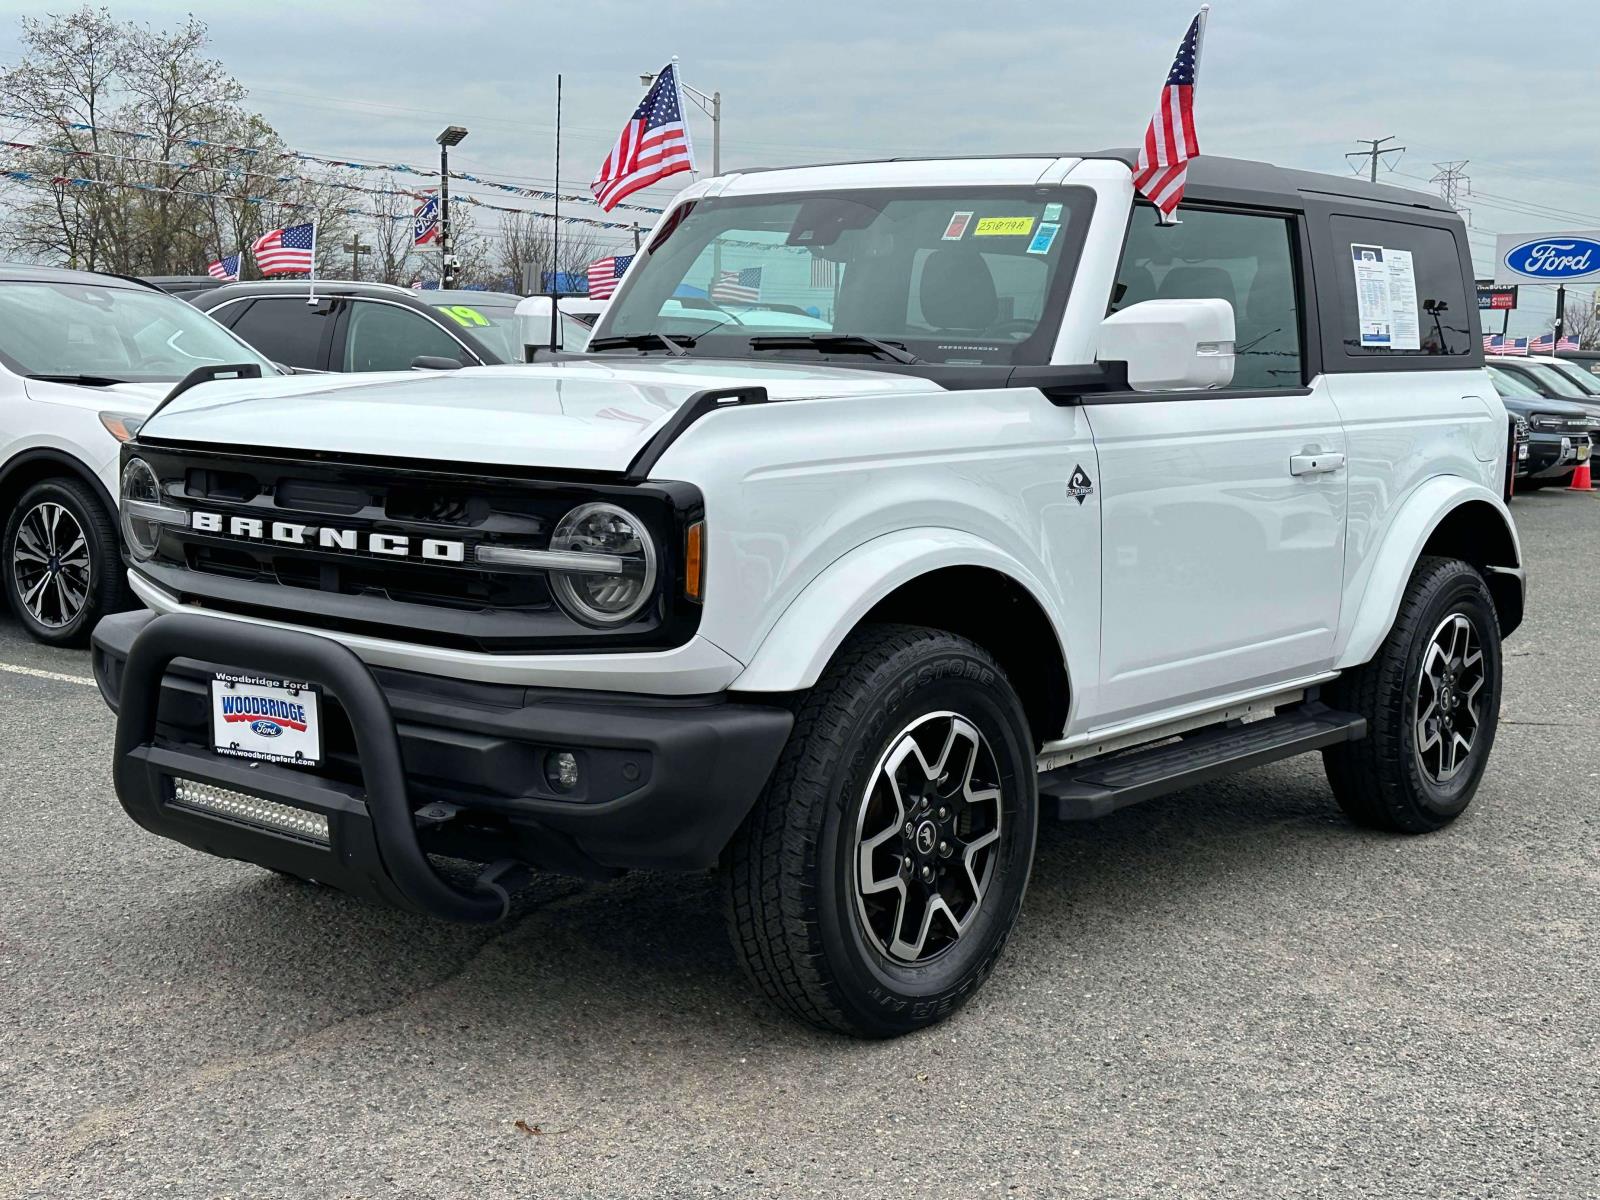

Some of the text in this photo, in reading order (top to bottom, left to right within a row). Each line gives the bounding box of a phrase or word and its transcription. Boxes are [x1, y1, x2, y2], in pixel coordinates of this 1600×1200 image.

[414, 201, 439, 234] Ford
[1524, 244, 1593, 272] Ford
[438, 305, 491, 327] 19
[192, 511, 465, 562] BRONCO
[215, 672, 309, 690] Woodbridge Ford
[222, 696, 306, 724] WOODBRIDGE
[256, 721, 277, 736] Ford
[216, 747, 316, 766] www.woodbridgeford.com
